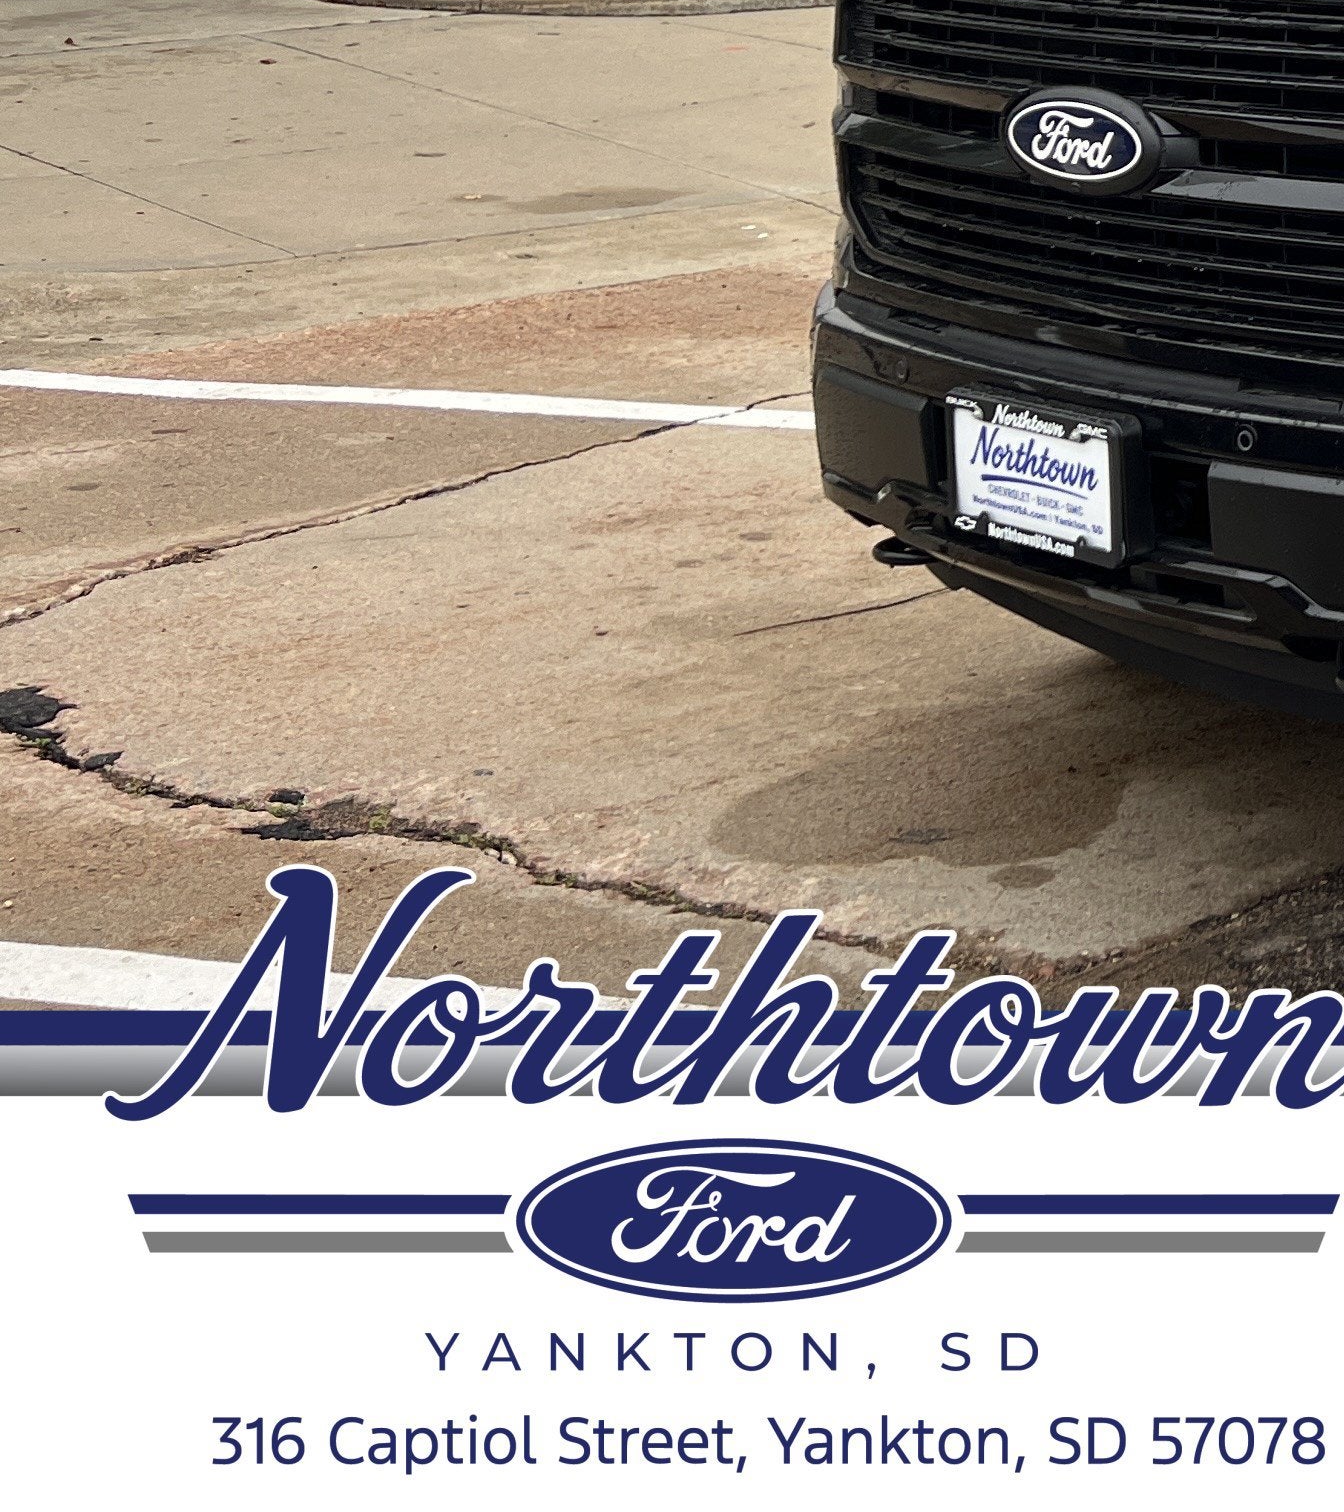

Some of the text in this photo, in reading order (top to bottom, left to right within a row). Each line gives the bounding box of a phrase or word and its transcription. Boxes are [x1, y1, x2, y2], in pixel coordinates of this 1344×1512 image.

[1031, 110, 1115, 169] Ford
[991, 403, 1066, 439] Northtown
[970, 426, 1099, 491] Northtown
[987, 521, 1075, 558] NorthtownUSA.com
